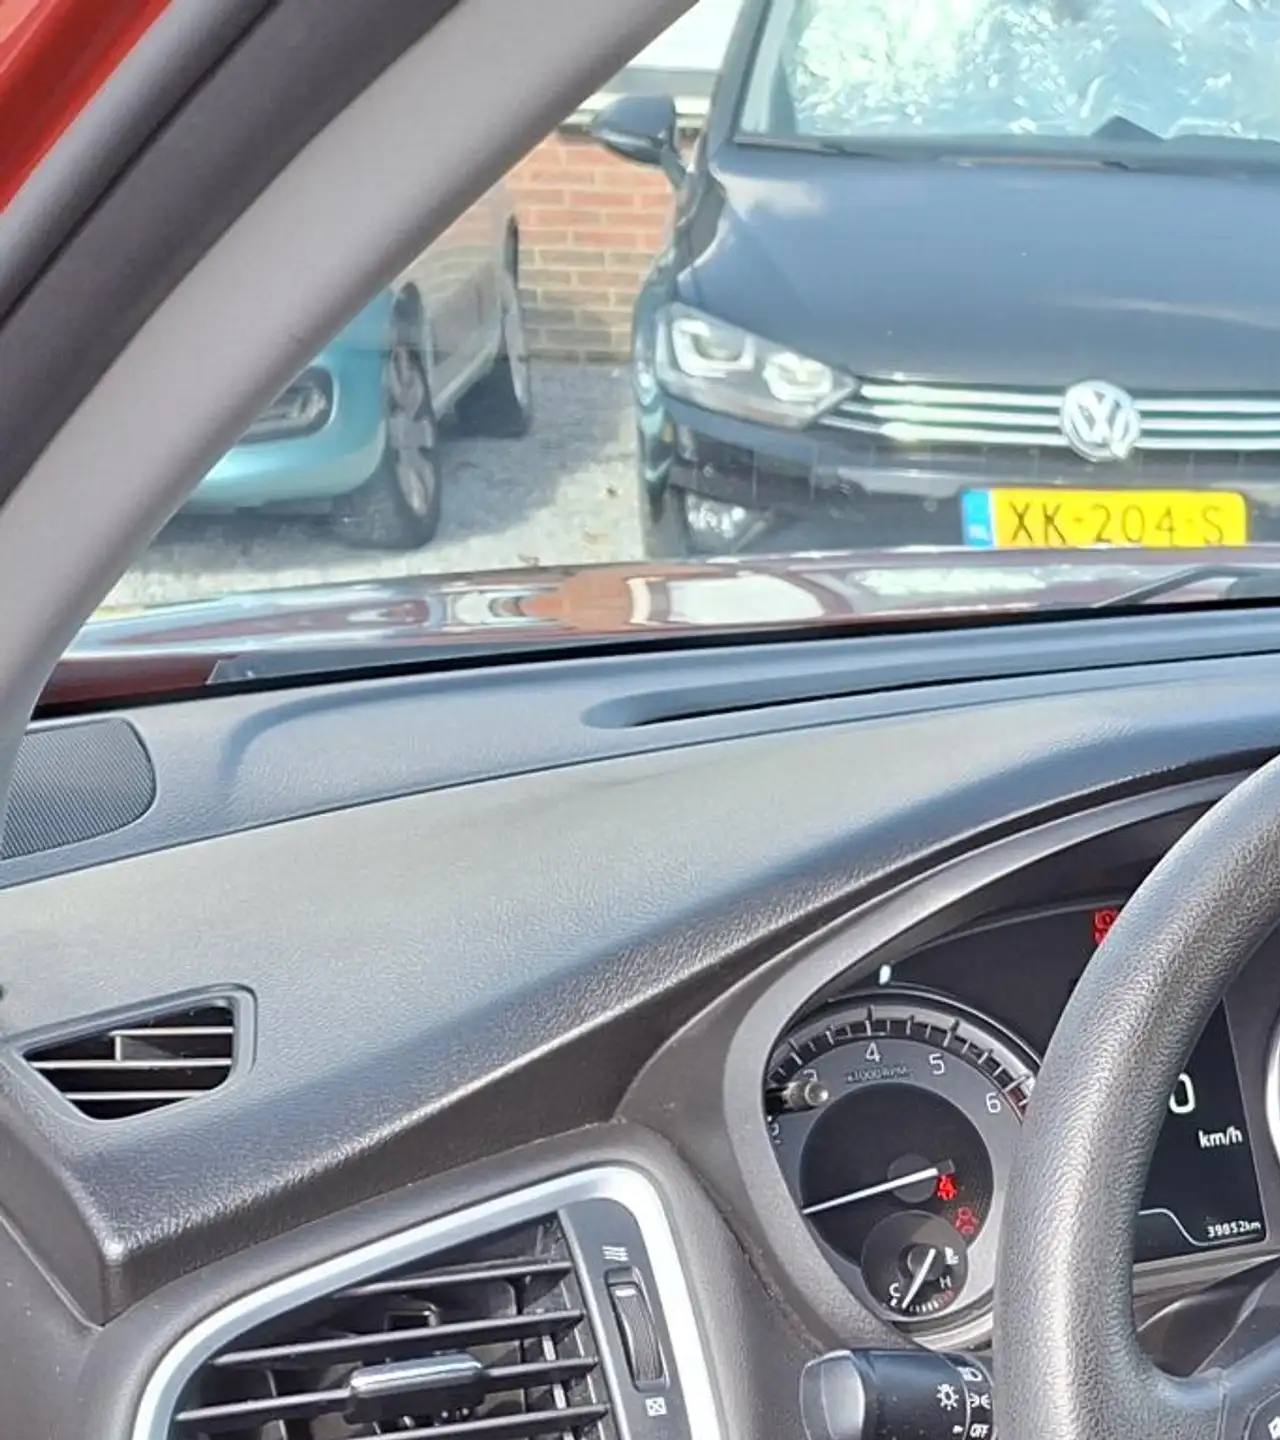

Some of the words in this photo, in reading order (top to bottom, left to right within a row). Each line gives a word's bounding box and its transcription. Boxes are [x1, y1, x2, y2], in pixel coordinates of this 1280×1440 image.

[1008, 499, 1228, 547] XK-204-S
[865, 1041, 881, 1063] 4
[929, 1053, 945, 1076] 5
[986, 1091, 1001, 1113] 6
[1198, 1125, 1243, 1148] km/h
[889, 1282, 901, 1297] C
[940, 1275, 952, 1290] H
[969, 1423, 990, 1439] OFF
